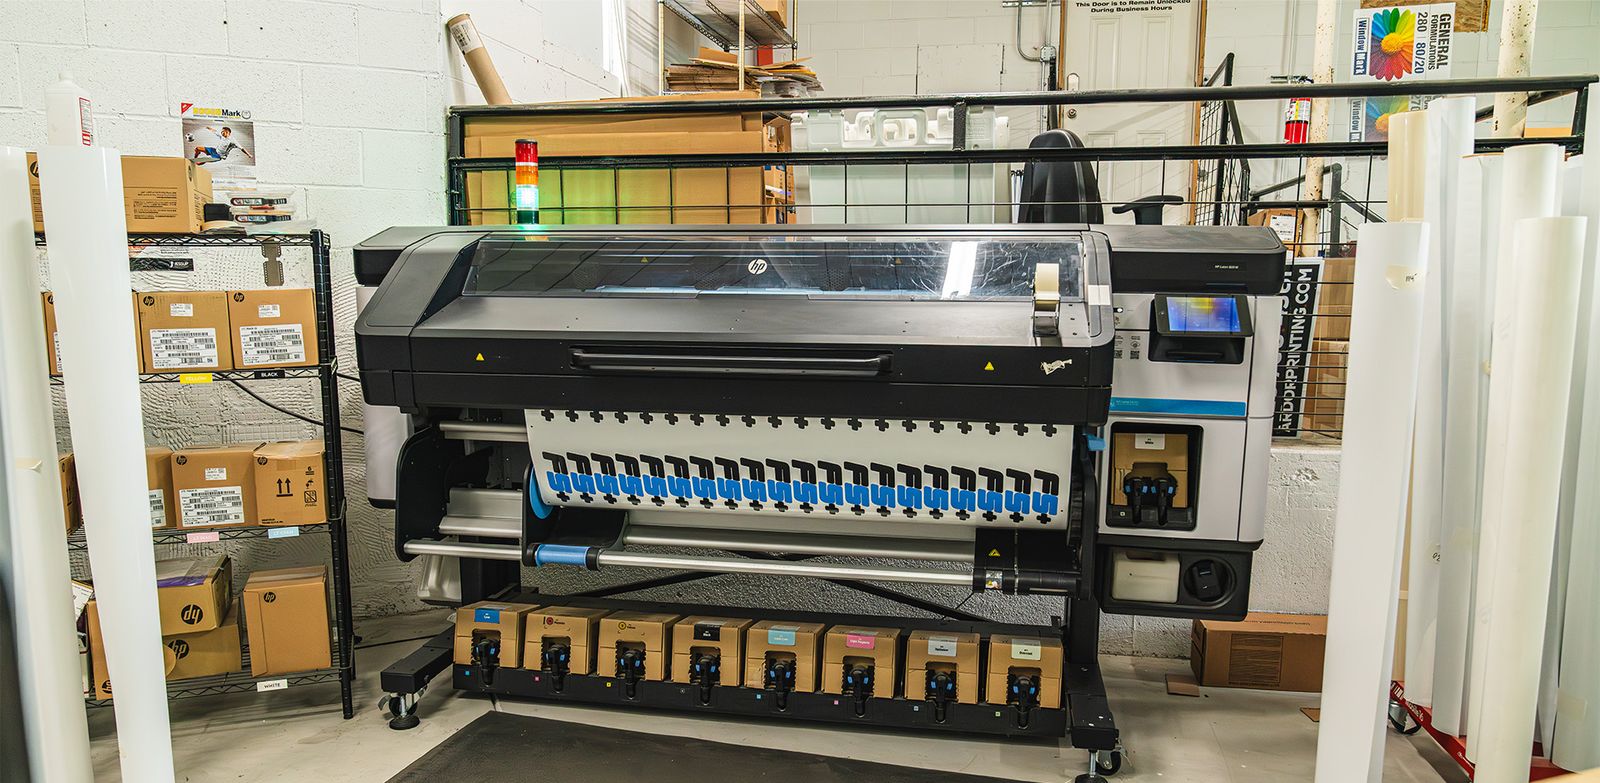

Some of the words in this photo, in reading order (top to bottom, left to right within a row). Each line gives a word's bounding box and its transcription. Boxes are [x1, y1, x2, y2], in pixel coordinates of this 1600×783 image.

[1357, 19, 1367, 51] Window
[1416, 11, 1428, 32] 280
[1427, 15, 1439, 70] FORMULATIONS
[1436, 13, 1452, 70] GENERAL
[1354, 53, 1366, 75] Mark
[1414, 42, 1427, 74] 80/20
[1351, 100, 1361, 131] Window
[748, 258, 768, 275] hp
[233, 292, 245, 303] hp
